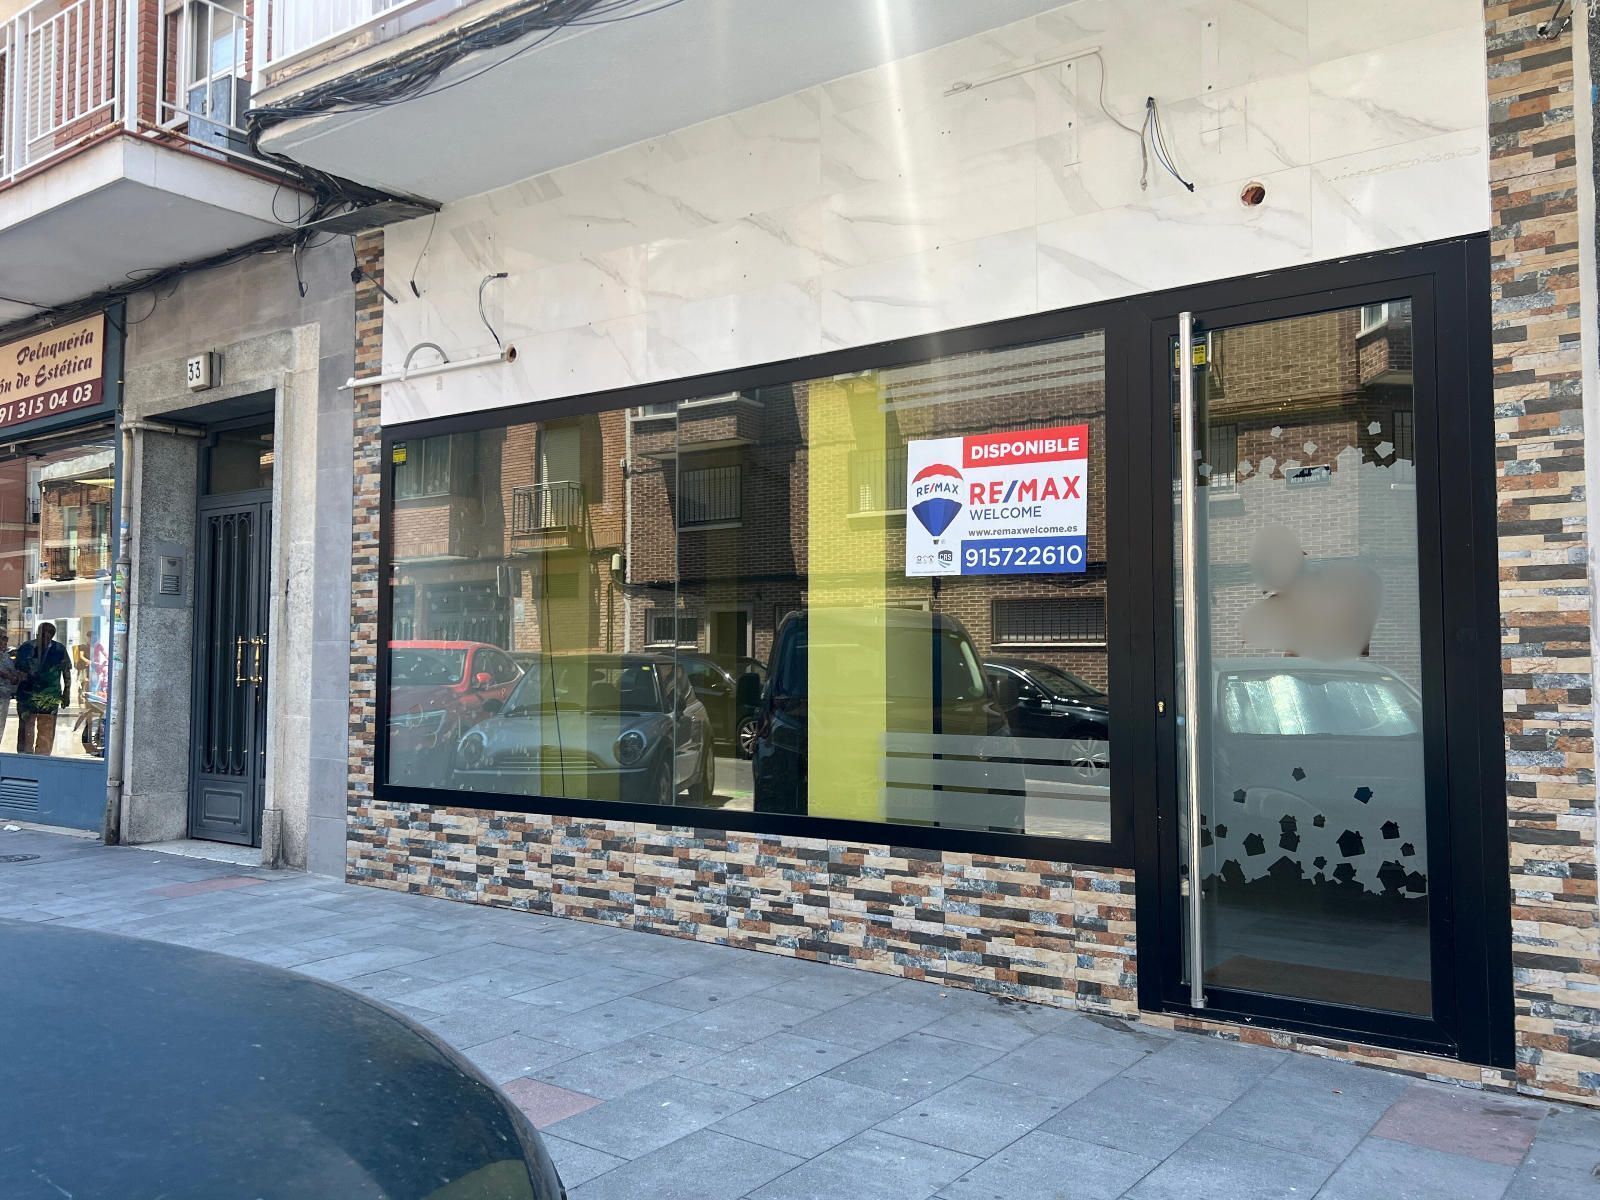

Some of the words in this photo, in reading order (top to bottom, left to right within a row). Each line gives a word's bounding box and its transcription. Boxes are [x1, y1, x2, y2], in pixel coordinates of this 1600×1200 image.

[16, 328, 94, 365] Peluquería
[16, 372, 31, 389] de
[35, 355, 93, 387] Estética
[188, 360, 201, 381] 33
[17, 396, 45, 419] 315
[49, 390, 68, 410] 04
[72, 384, 93, 404] 03
[971, 437, 1080, 460] DISPONIBLE
[916, 482, 959, 498] RE/MAX
[969, 475, 1081, 506] RE/MAX
[969, 505, 1042, 521] WELCOME
[968, 525, 1078, 537] www.remaxwelcome.es
[965, 544, 1083, 568] 915722610
